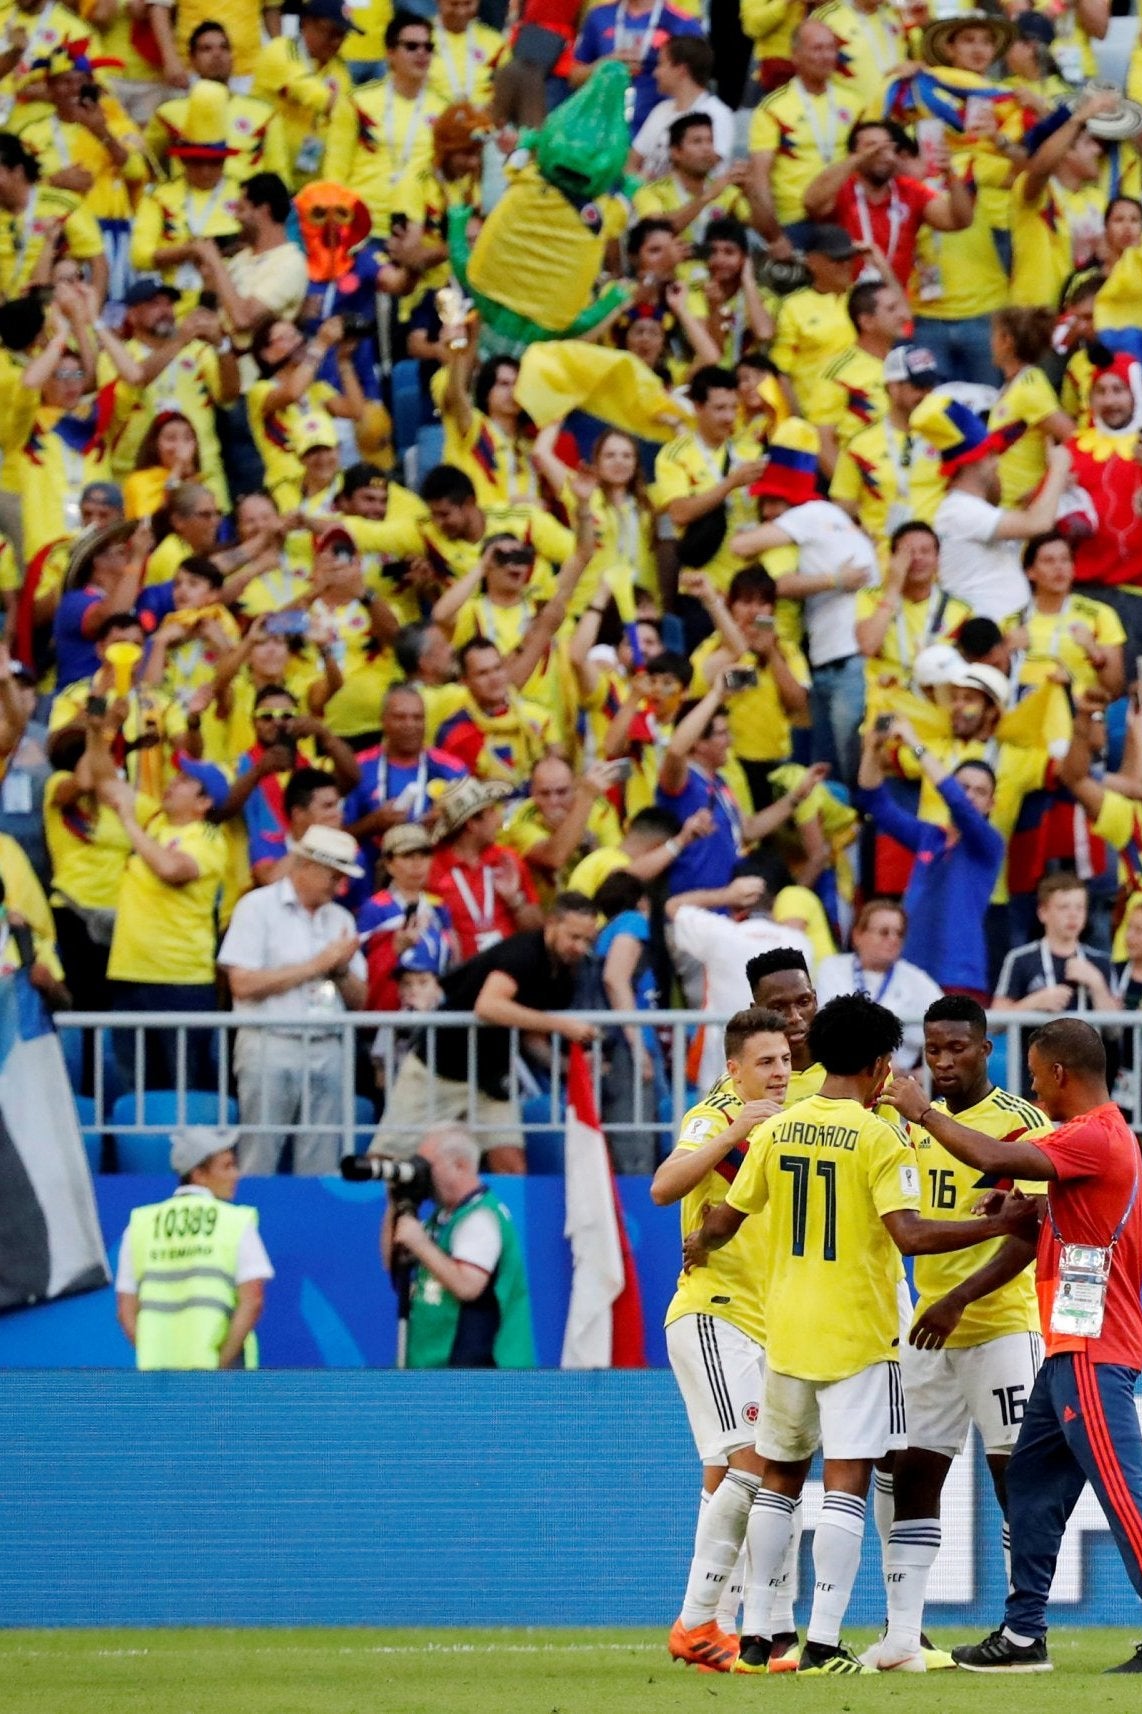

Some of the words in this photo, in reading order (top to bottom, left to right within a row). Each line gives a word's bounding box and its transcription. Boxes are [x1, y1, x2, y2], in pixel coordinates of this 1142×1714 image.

[780, 1155, 837, 1261] 11
[928, 1169, 957, 1210] 16
[152, 1207, 218, 1239] 10389
[992, 1384, 1028, 1427] 16
